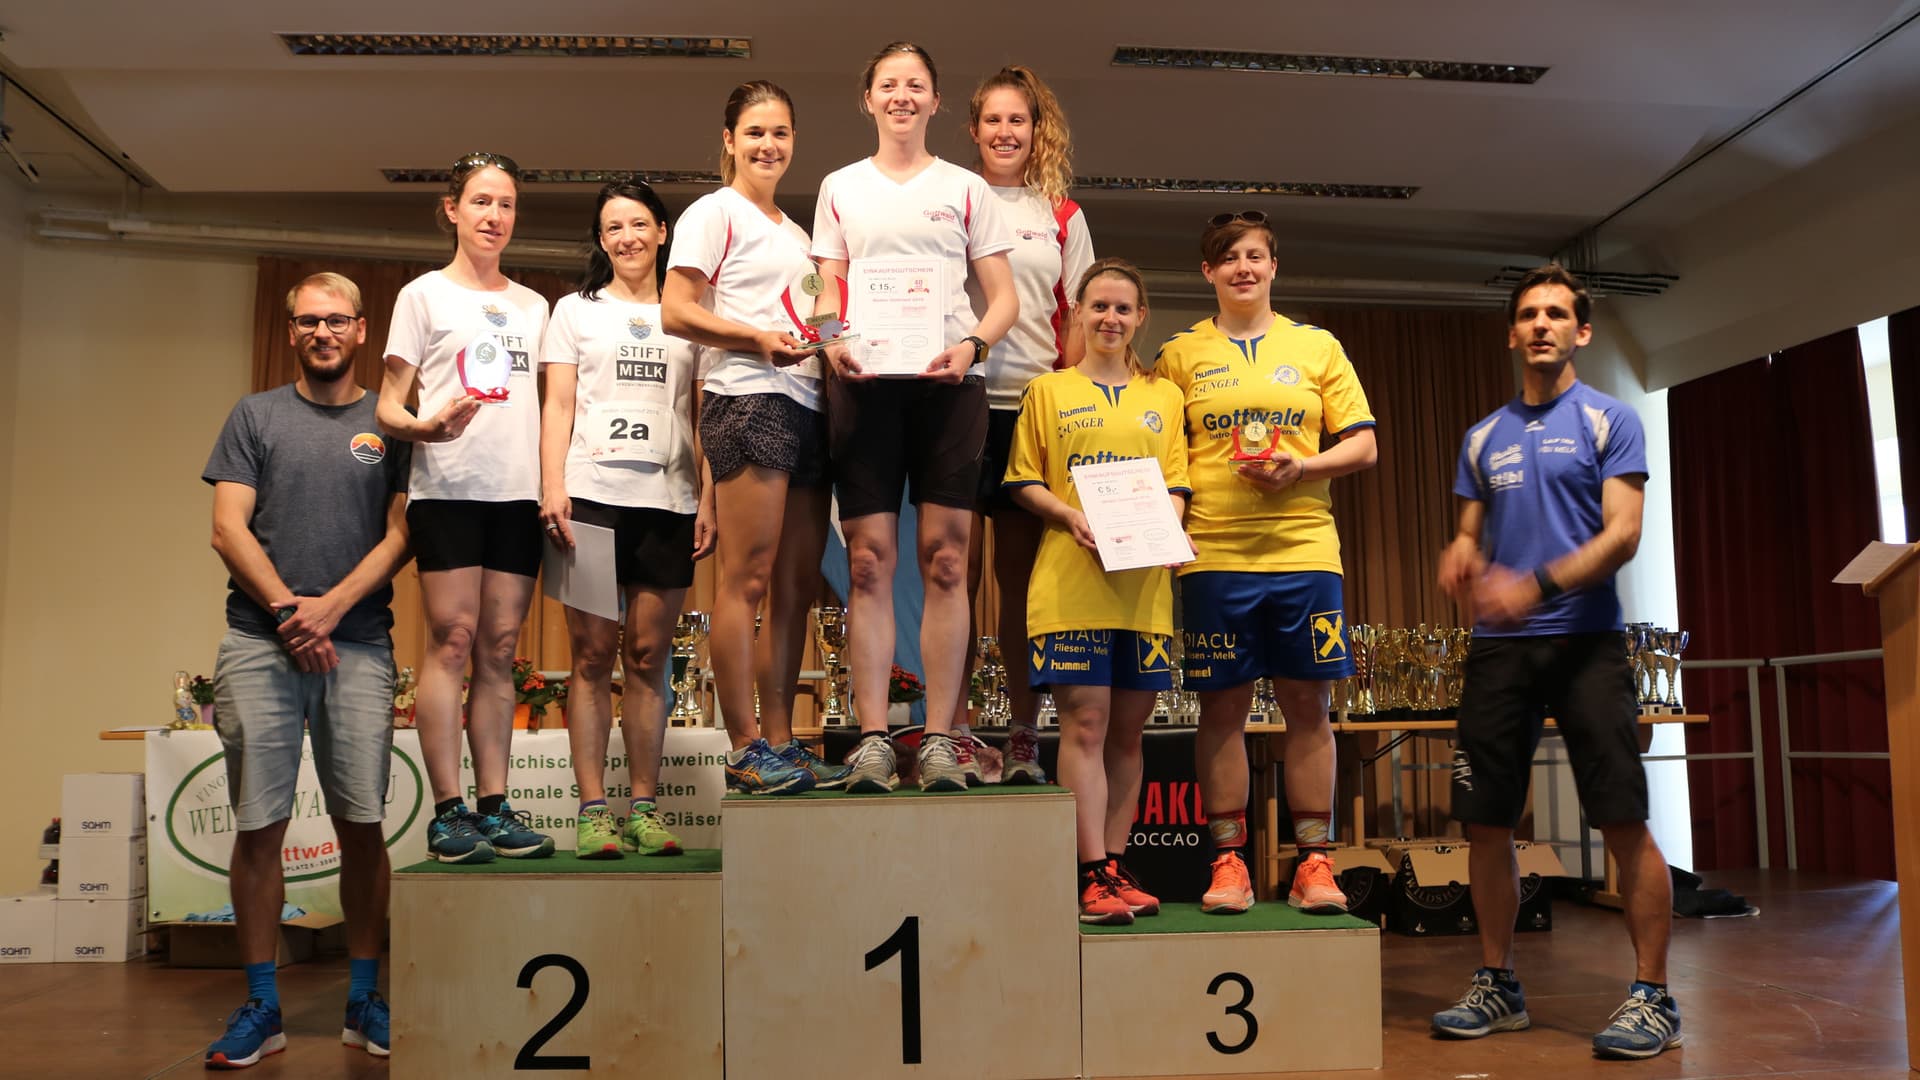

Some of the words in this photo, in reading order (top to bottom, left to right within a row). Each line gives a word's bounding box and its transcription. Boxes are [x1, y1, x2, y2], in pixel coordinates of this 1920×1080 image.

[620, 345, 664, 360] STIFT
[619, 363, 663, 379] MELK
[1194, 364, 1230, 380] hummel
[1202, 378, 1239, 393] UNGER
[1059, 404, 1096, 418] hummel
[1067, 418, 1104, 434] UNGER
[1202, 408, 1305, 431] Gottwald
[609, 417, 650, 441] 2a
[1054, 643, 1086, 653] Fliesen
[1213, 651, 1237, 660] Melk
[1051, 659, 1090, 671] hummel
[468, 785, 563, 799] Rionale
[864, 915, 921, 1065] 1
[514, 953, 591, 1071] 2
[1205, 971, 1259, 1055] 3
